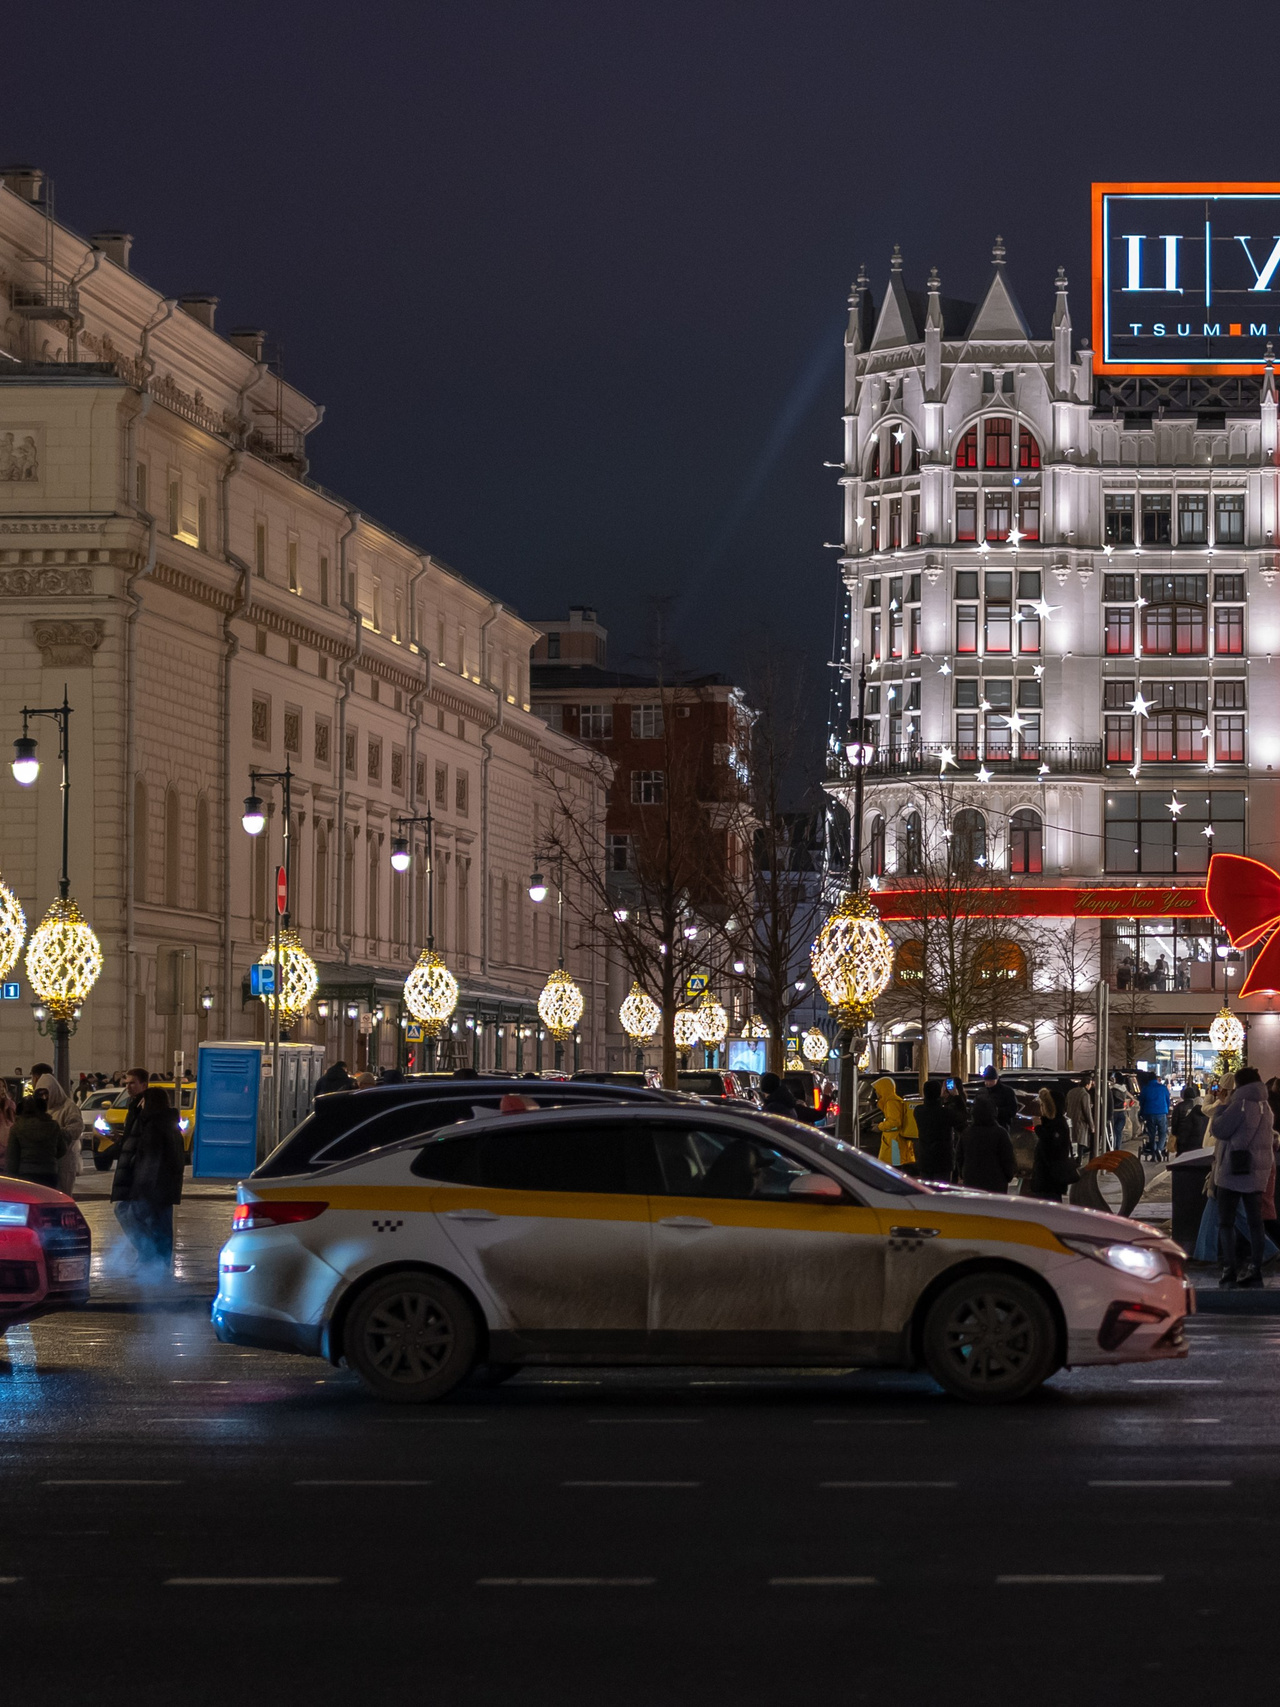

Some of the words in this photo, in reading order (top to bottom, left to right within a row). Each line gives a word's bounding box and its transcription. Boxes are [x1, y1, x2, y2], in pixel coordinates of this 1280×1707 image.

[1129, 323, 1220, 336] TSUM
[1074, 891, 1121, 914] Happy
[1120, 891, 1155, 908] New
[1159, 890, 1198, 913] Year
